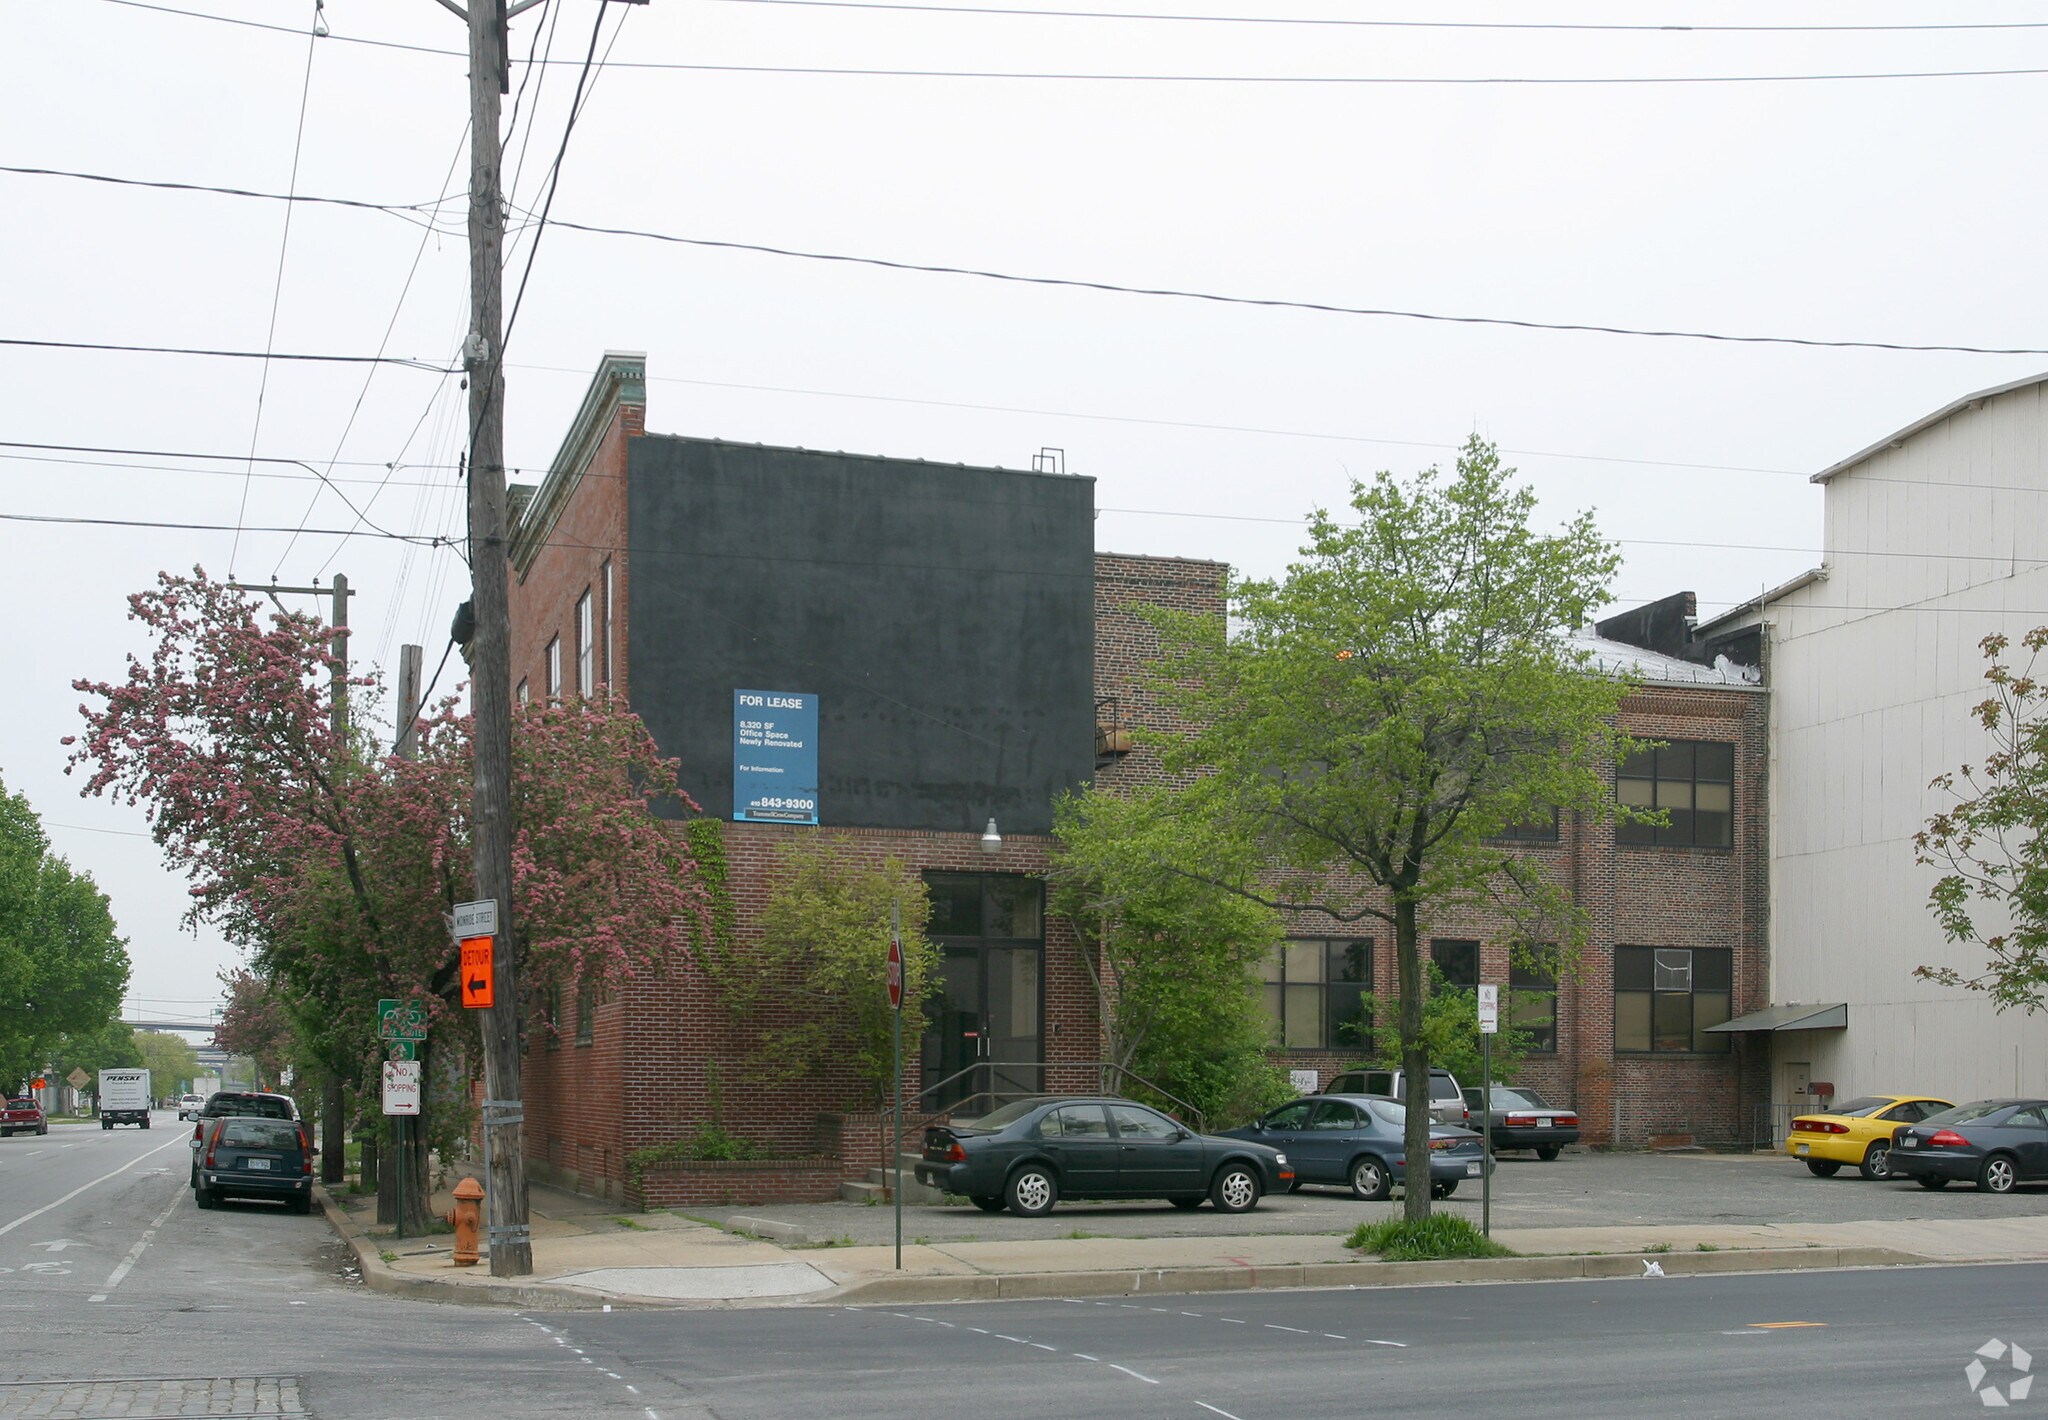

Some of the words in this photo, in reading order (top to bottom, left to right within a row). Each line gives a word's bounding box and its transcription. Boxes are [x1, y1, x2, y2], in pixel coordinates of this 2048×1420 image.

[740, 695, 763, 706] FOR
[767, 697, 803, 709] LEASE
[740, 720, 762, 729] 8,320
[764, 722, 774, 730] SF
[740, 729, 763, 737] Office
[765, 730, 789, 739] Space
[740, 737, 762, 746] Newly
[764, 738, 803, 748] Renovated
[761, 797, 814, 810] 843-9300
[456, 914, 475, 926] MONROE
[475, 911, 493, 924] STREET
[463, 949, 489, 966] DETOUR
[888, 961, 900, 986] STOP
[395, 1068, 408, 1077] NO
